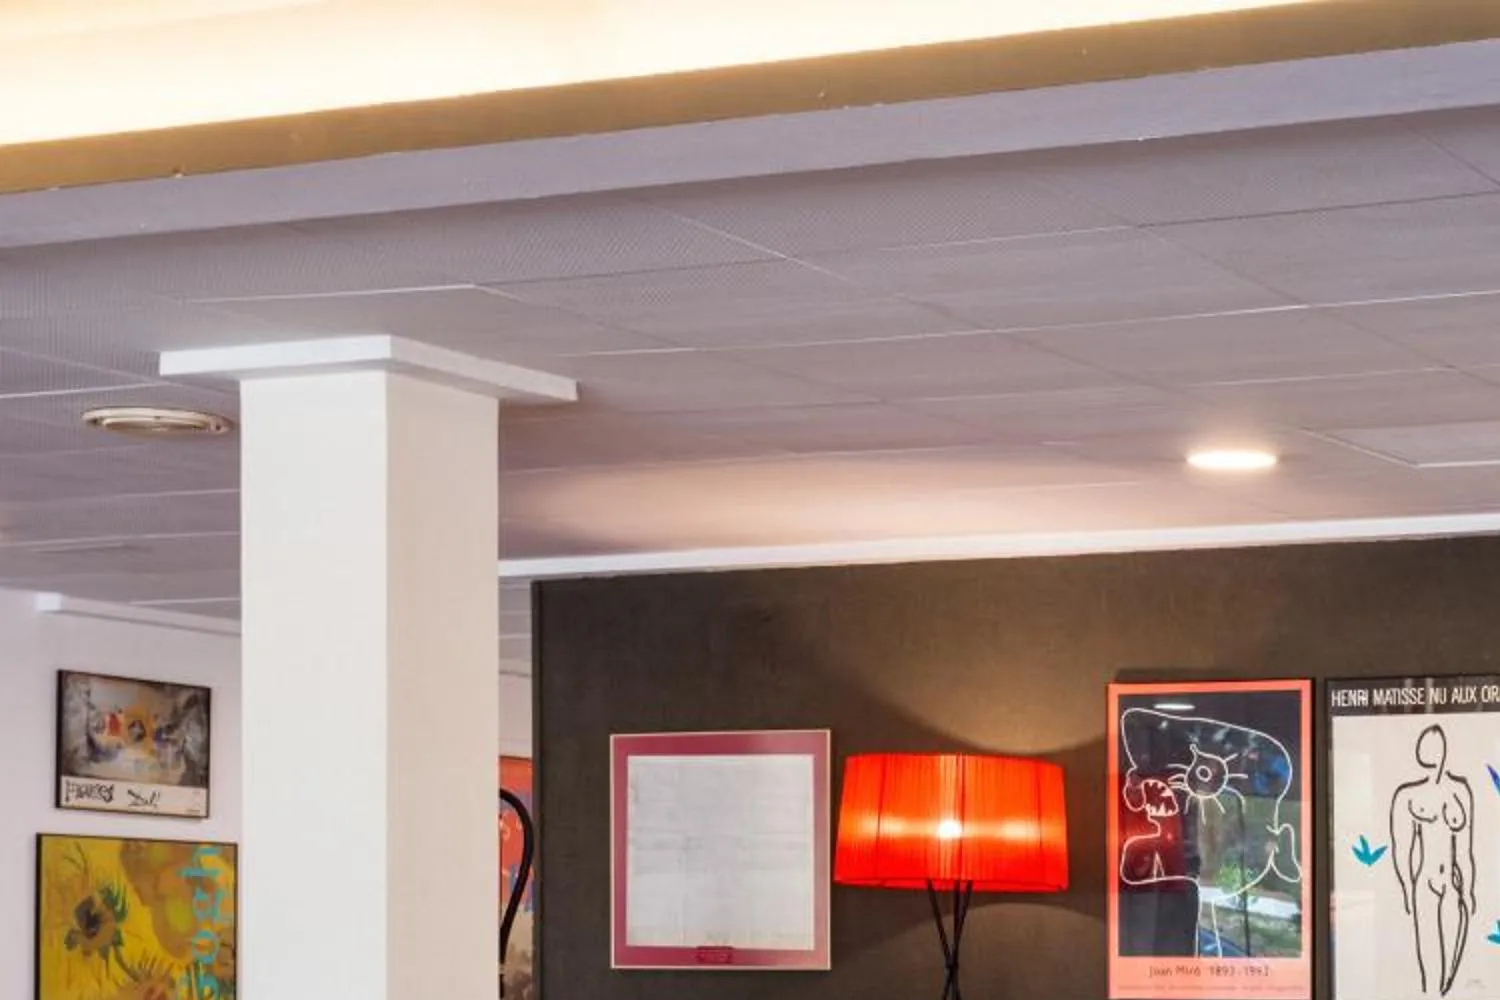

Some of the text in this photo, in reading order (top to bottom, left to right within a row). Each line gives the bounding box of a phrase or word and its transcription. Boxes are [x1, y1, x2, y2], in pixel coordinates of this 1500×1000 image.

[1331, 689, 1369, 707] HENRI
[1373, 687, 1425, 705] MATISSE
[1428, 687, 1447, 704] NU
[1451, 686, 1477, 704] AUX
